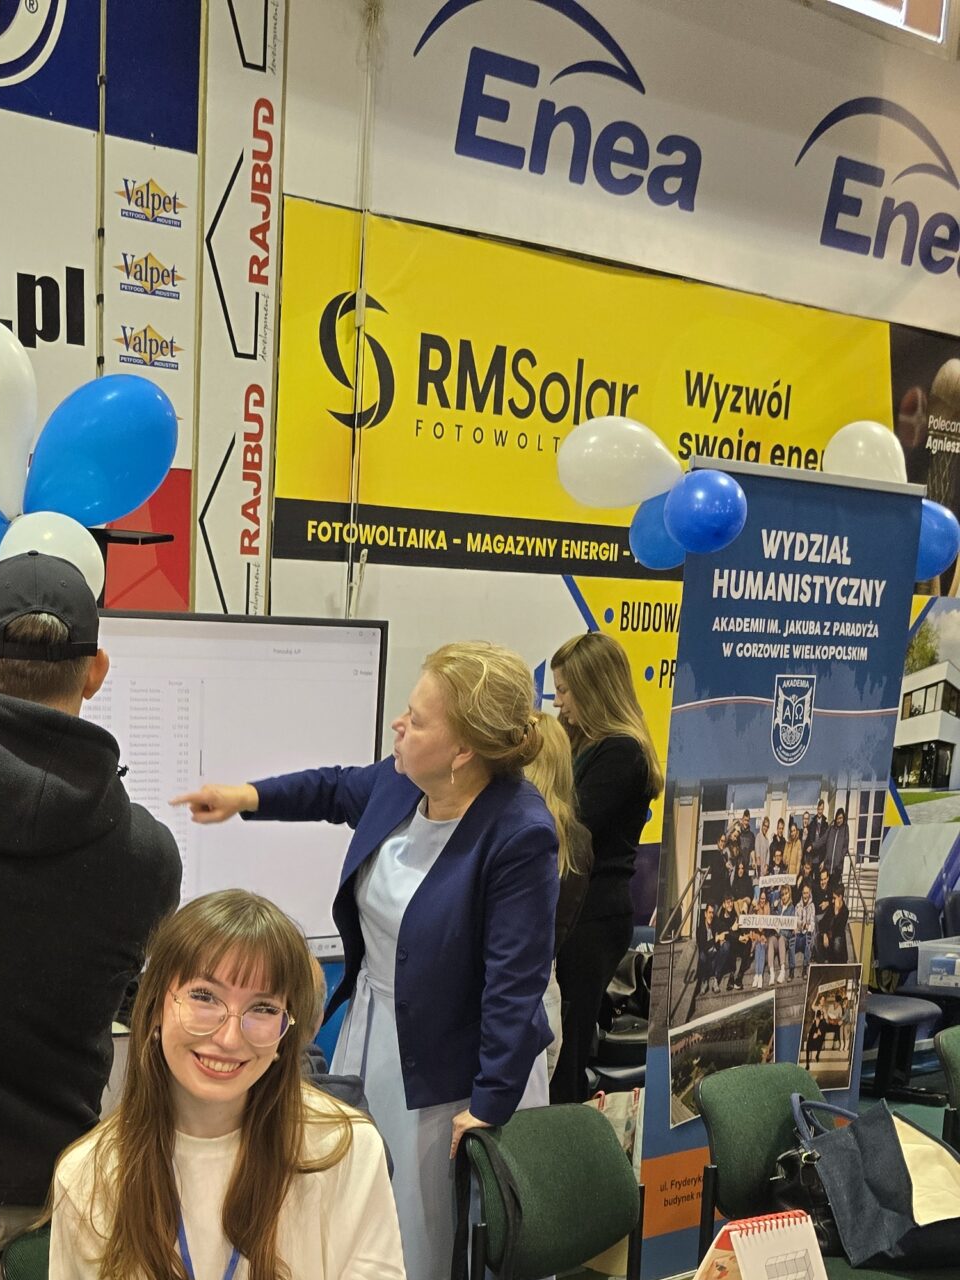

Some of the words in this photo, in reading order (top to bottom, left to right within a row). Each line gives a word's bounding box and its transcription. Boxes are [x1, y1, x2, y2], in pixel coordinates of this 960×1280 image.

[454, 46, 702, 212] Enea
[123, 178, 179, 218] Valpet
[248, 97, 275, 286] RAJBUD
[122, 211, 146, 220] PETFOOD
[156, 217, 181, 227] INDUSTRY
[819, 155, 960, 276] Ene
[121, 252, 178, 291] Valpet
[121, 284, 145, 293] PETFOOD
[155, 290, 179, 299] INDUSTRY
[120, 325, 176, 361] Valpet
[120, 356, 144, 365] PETFOOD
[153, 361, 178, 369] INDUSTRY
[417, 332, 639, 426] RMSolar
[685, 370, 792, 424] Wyzwól
[416, 419, 561, 454] FOTOWOLT
[240, 383, 265, 556] RAJBUD
[307, 520, 448, 551] FOTOWOLTAIKA
[467, 532, 558, 559] MAGAZYNY
[561, 539, 619, 563] ENERGII
[761, 529, 851, 565] WYDZIAŁ
[712, 568, 887, 607] HUMANISTYCZNY
[712, 616, 765, 633] AKADEMII
[766, 619, 781, 634] IM.
[783, 619, 821, 638] JAKUBA
[823, 621, 831, 636] Z
[832, 620, 879, 638] PARADYŻA
[722, 642, 734, 658] W
[736, 642, 791, 659] GORZOWIE
[792, 644, 868, 661] WIELKOPOLSKIM
[782, 679, 810, 689] AKADEMIA
[670, 1173, 704, 1190] Fryderyk
